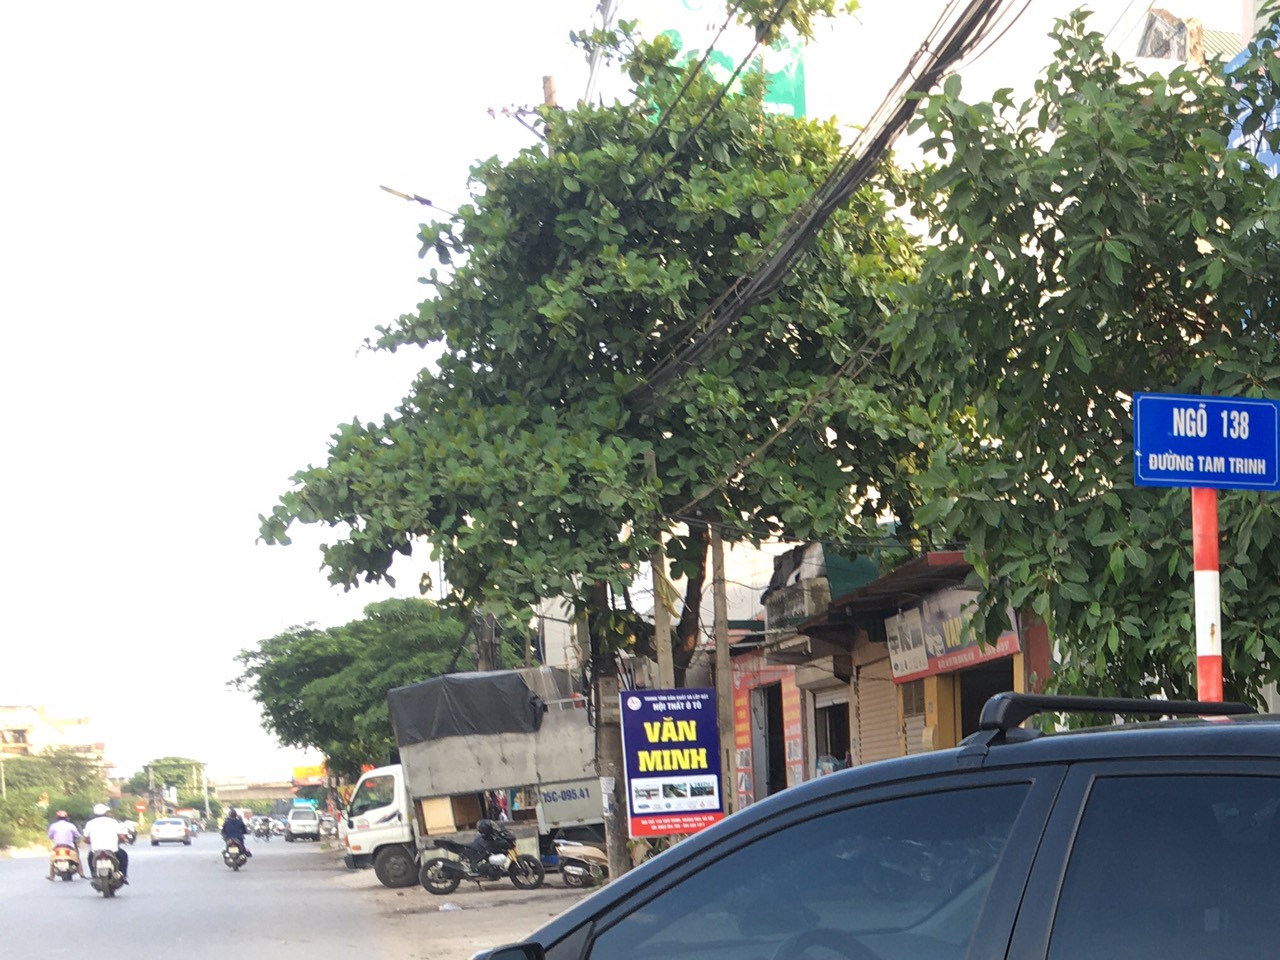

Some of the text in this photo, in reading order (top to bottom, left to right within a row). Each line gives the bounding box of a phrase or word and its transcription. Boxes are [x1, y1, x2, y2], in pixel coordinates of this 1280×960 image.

[1172, 402, 1250, 440] NGÕ 138
[1148, 448, 1267, 475] ĐƯỜNG TAM TRINH
[643, 716, 697, 743] VĂN
[638, 747, 708, 772] MINH
